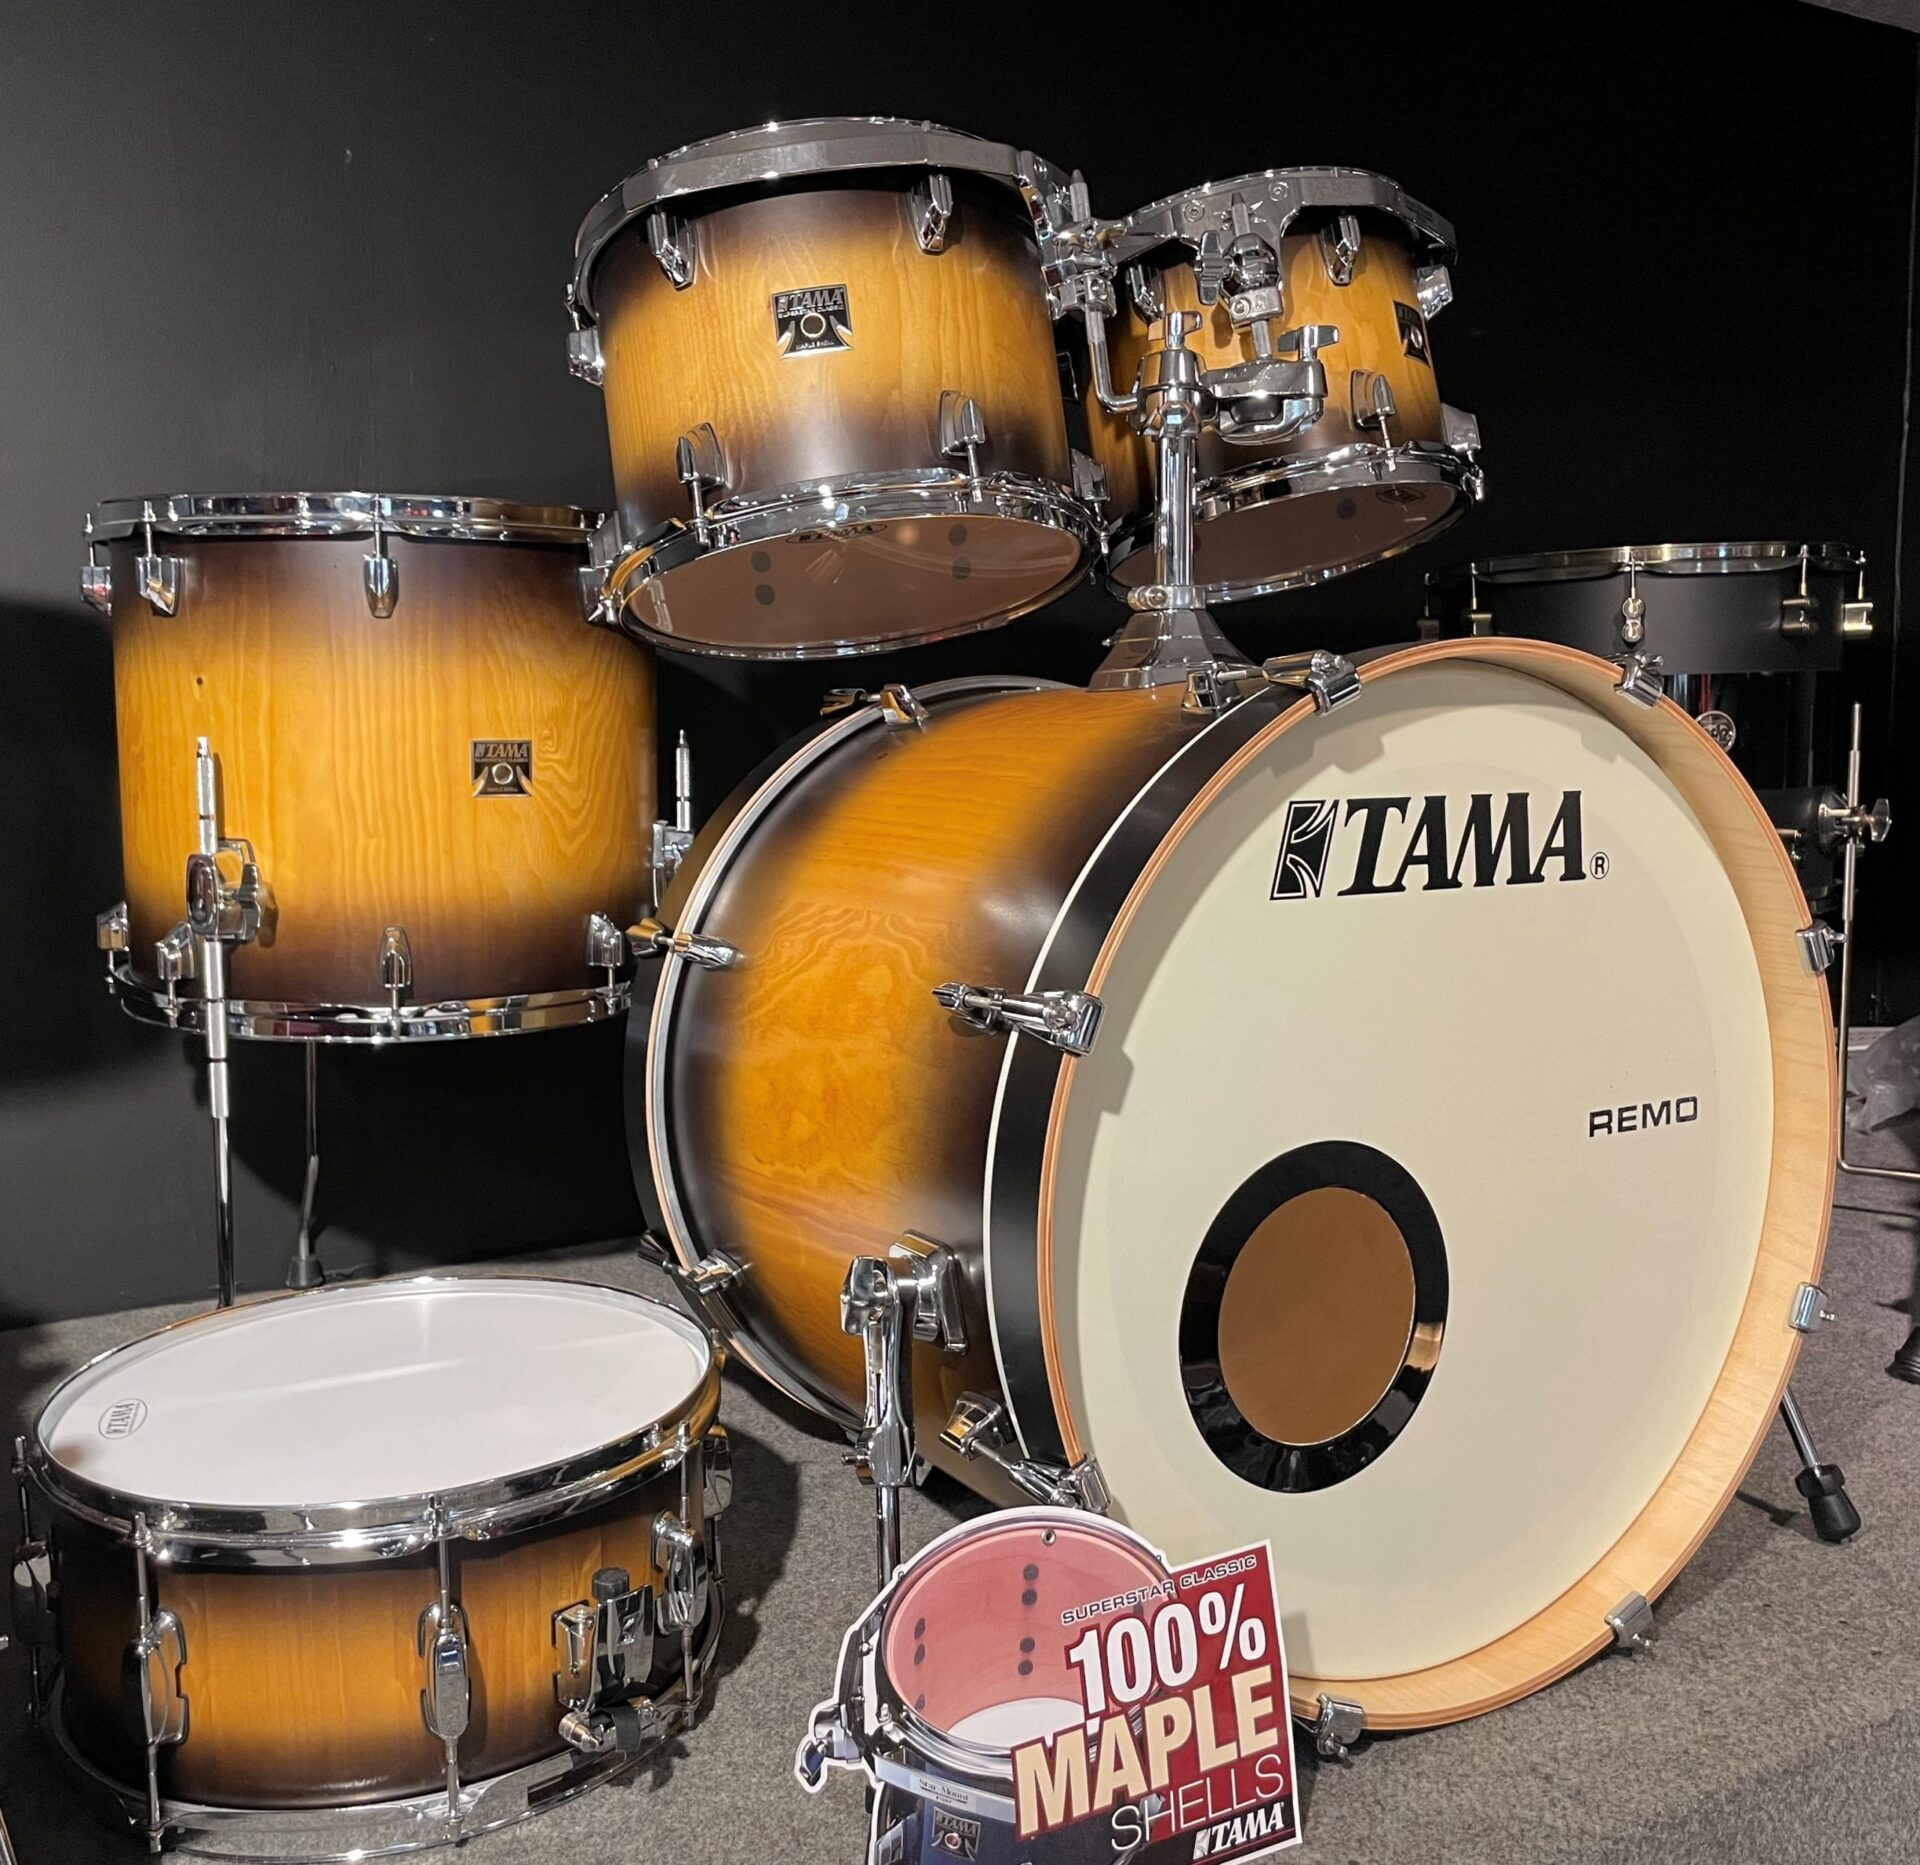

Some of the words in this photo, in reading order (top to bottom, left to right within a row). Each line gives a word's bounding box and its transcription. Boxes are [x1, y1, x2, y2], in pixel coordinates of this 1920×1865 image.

[789, 288, 844, 311] TAMA
[486, 743, 529, 758] TAMA
[1336, 790, 1588, 897] TAMA
[1588, 1096, 1698, 1138] REMO
[106, 1403, 135, 1430] TAMA
[1061, 1579, 1176, 1625] SUPERSTAR
[1180, 1555, 1257, 1589] CLASSIC
[1069, 1583, 1267, 1715] 100%
[1015, 1665, 1279, 1836] MAPLE
[943, 1815, 977, 1834] TAMA
[1111, 1753, 1284, 1850] SHELLS
[1210, 1802, 1286, 1853] TAMA
